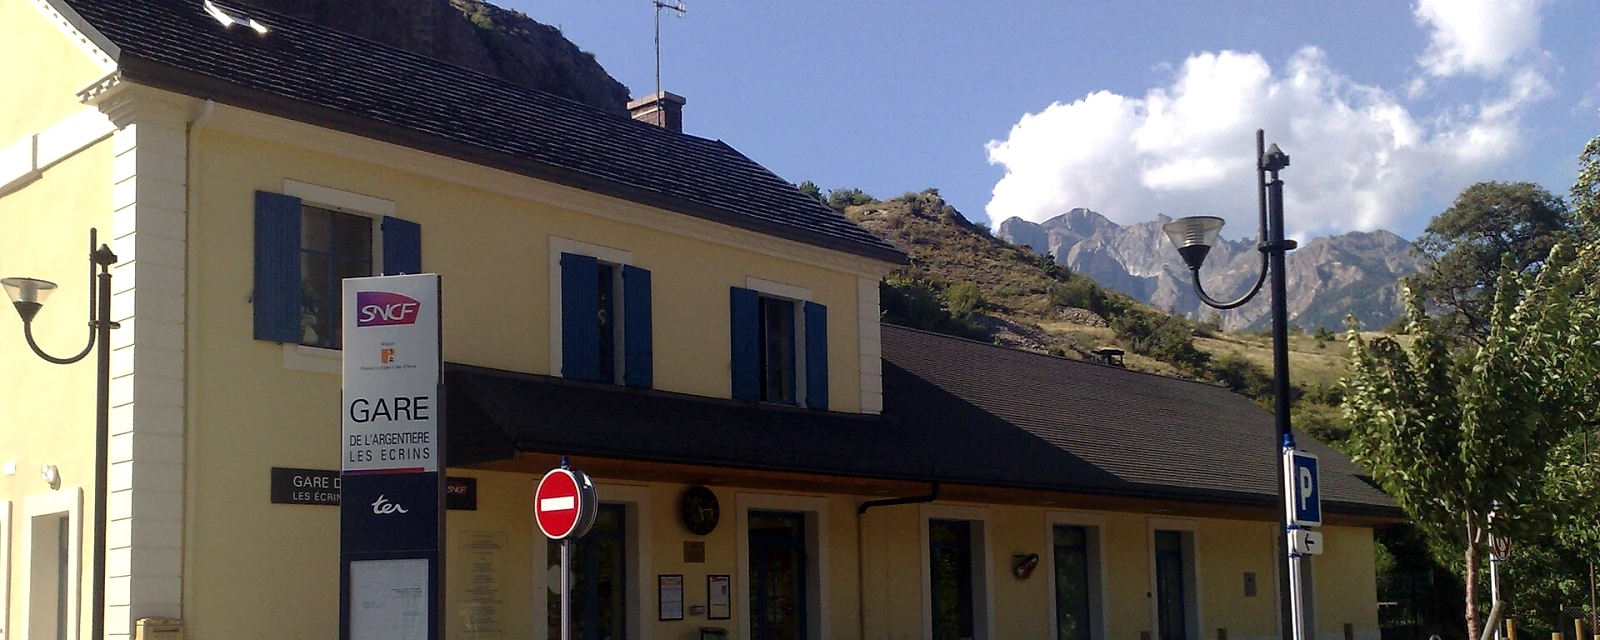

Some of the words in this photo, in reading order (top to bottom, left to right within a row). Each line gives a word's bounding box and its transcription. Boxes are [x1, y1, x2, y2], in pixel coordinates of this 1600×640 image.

[360, 303, 417, 322] SNCF
[350, 396, 429, 423] GARE
[350, 434, 362, 446] DE
[365, 432, 430, 446] L'ARGENTIERE
[350, 450, 373, 462] LES
[381, 448, 430, 461] ECRINS
[293, 475, 329, 489] GARE
[334, 477, 341, 489] D
[1300, 466, 1313, 511] P
[292, 491, 311, 501] LES
[314, 490, 341, 502] ÉCRIN
[371, 494, 409, 515] ter
